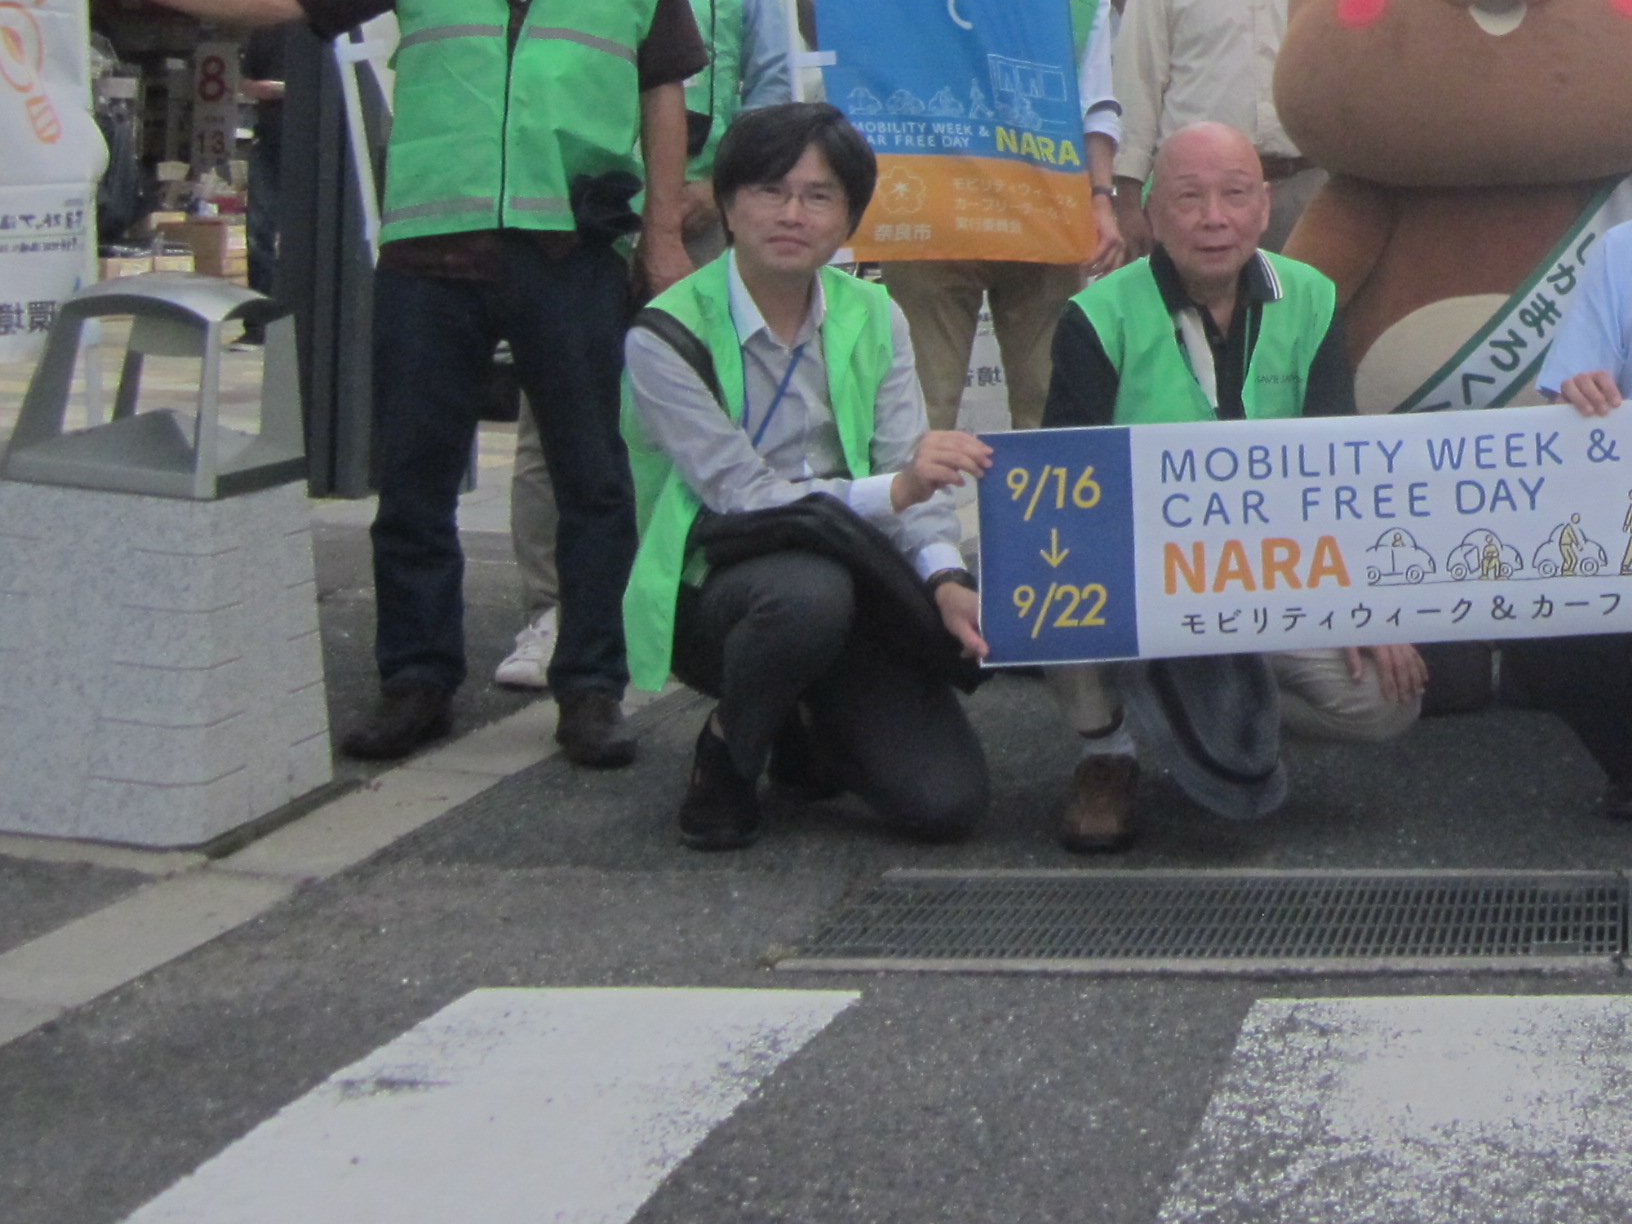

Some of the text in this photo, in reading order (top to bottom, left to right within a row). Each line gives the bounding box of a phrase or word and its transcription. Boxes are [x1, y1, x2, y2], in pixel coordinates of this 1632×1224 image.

[895, 136, 937, 147] FREE
[942, 136, 970, 147] DAY
[933, 123, 973, 136] WEEK
[995, 126, 1081, 166] NARA
[873, 223, 932, 242] 奈良市
[1160, 428, 1621, 484] MOBILITY WEEK &
[1005, 466, 1102, 521] 9/16
[1162, 476, 1547, 527] CAR FREE DAY
[1163, 534, 1351, 594] NARA
[1011, 582, 1106, 638] 9/22
